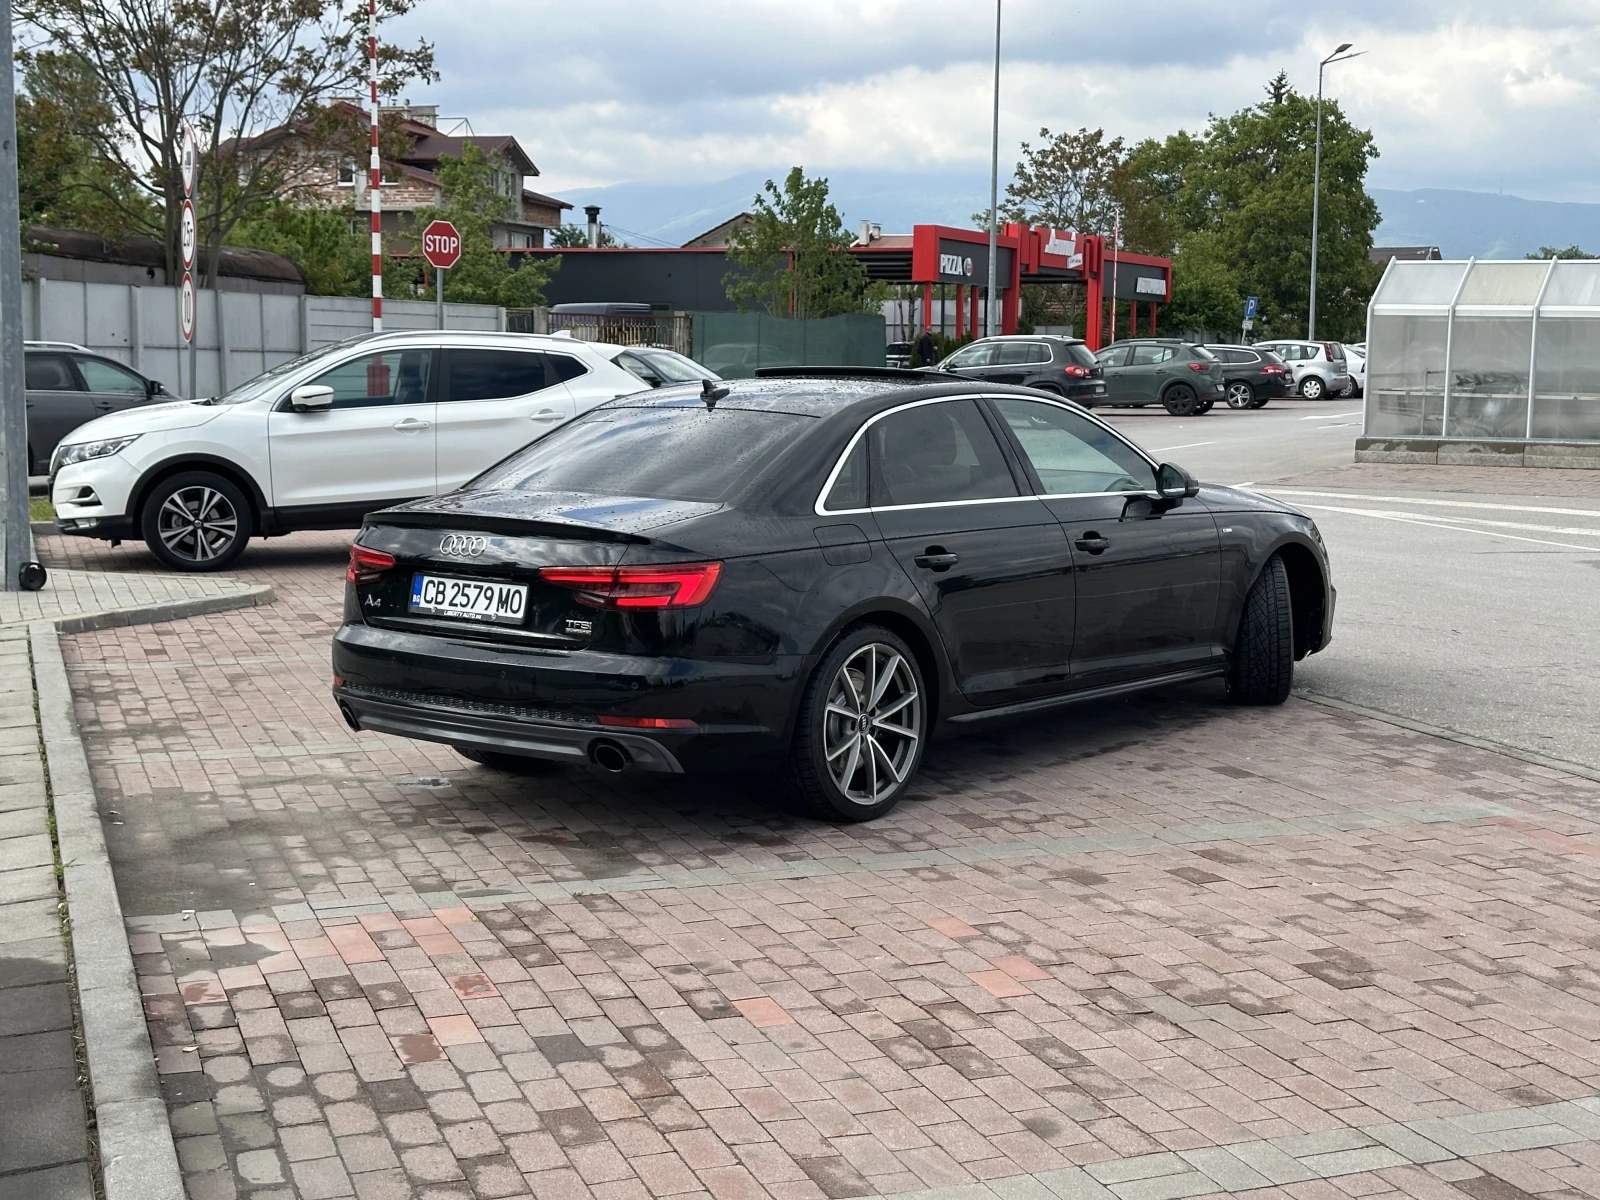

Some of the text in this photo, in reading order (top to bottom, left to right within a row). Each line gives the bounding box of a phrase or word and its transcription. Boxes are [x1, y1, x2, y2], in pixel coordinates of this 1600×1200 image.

[425, 234, 458, 254] STOP
[939, 253, 964, 276] PIZZA
[184, 291, 191, 324] 10
[1247, 299, 1255, 315] P
[364, 593, 382, 608] A4
[423, 579, 523, 614] CB 2579 MO
